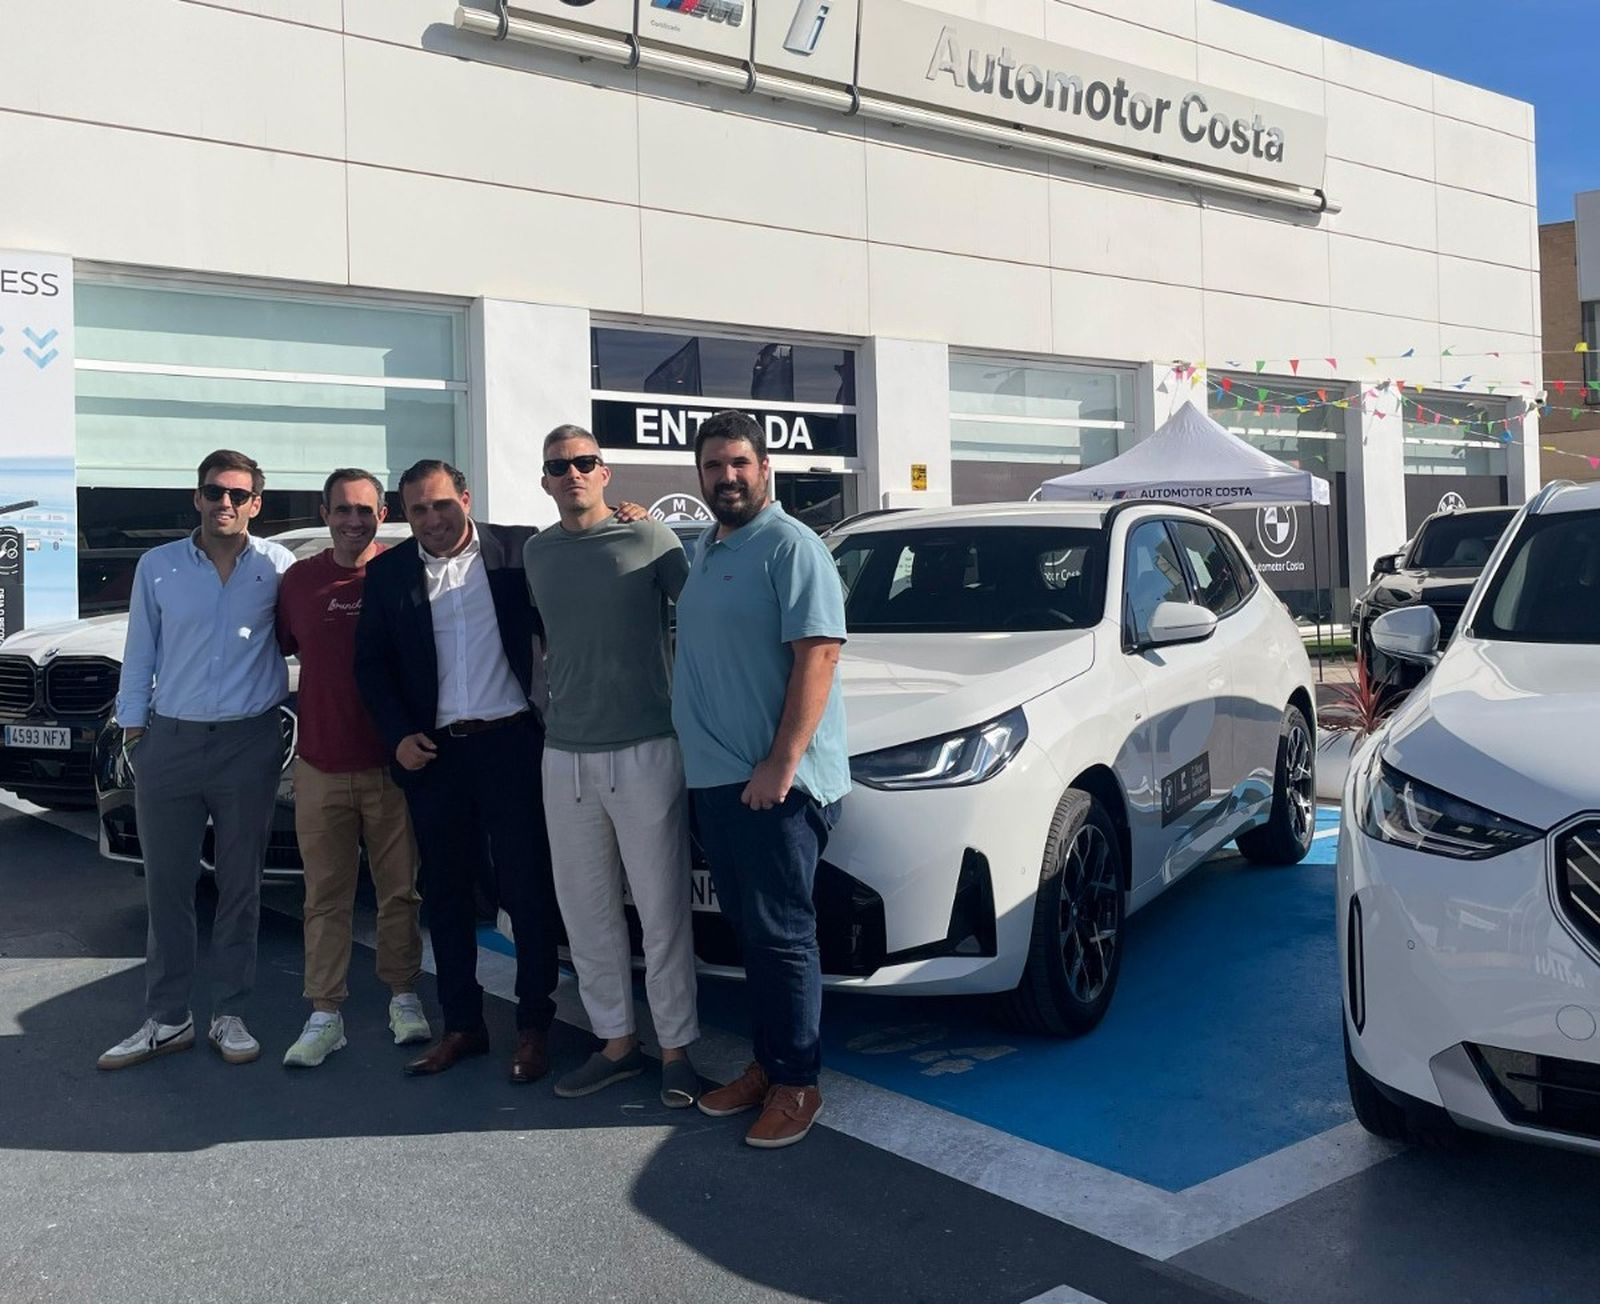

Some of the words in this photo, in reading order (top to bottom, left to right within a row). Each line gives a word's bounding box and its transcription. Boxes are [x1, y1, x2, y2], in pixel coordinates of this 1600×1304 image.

[926, 25, 1170, 134] Automotor
[1179, 91, 1284, 162] Costa
[1140, 488, 1212, 498] AUTOMOTOR
[1215, 487, 1253, 497] COSTA
[1286, 561, 1305, 571] Costa
[12, 728, 40, 744] 4593
[43, 730, 66, 746] NFX
